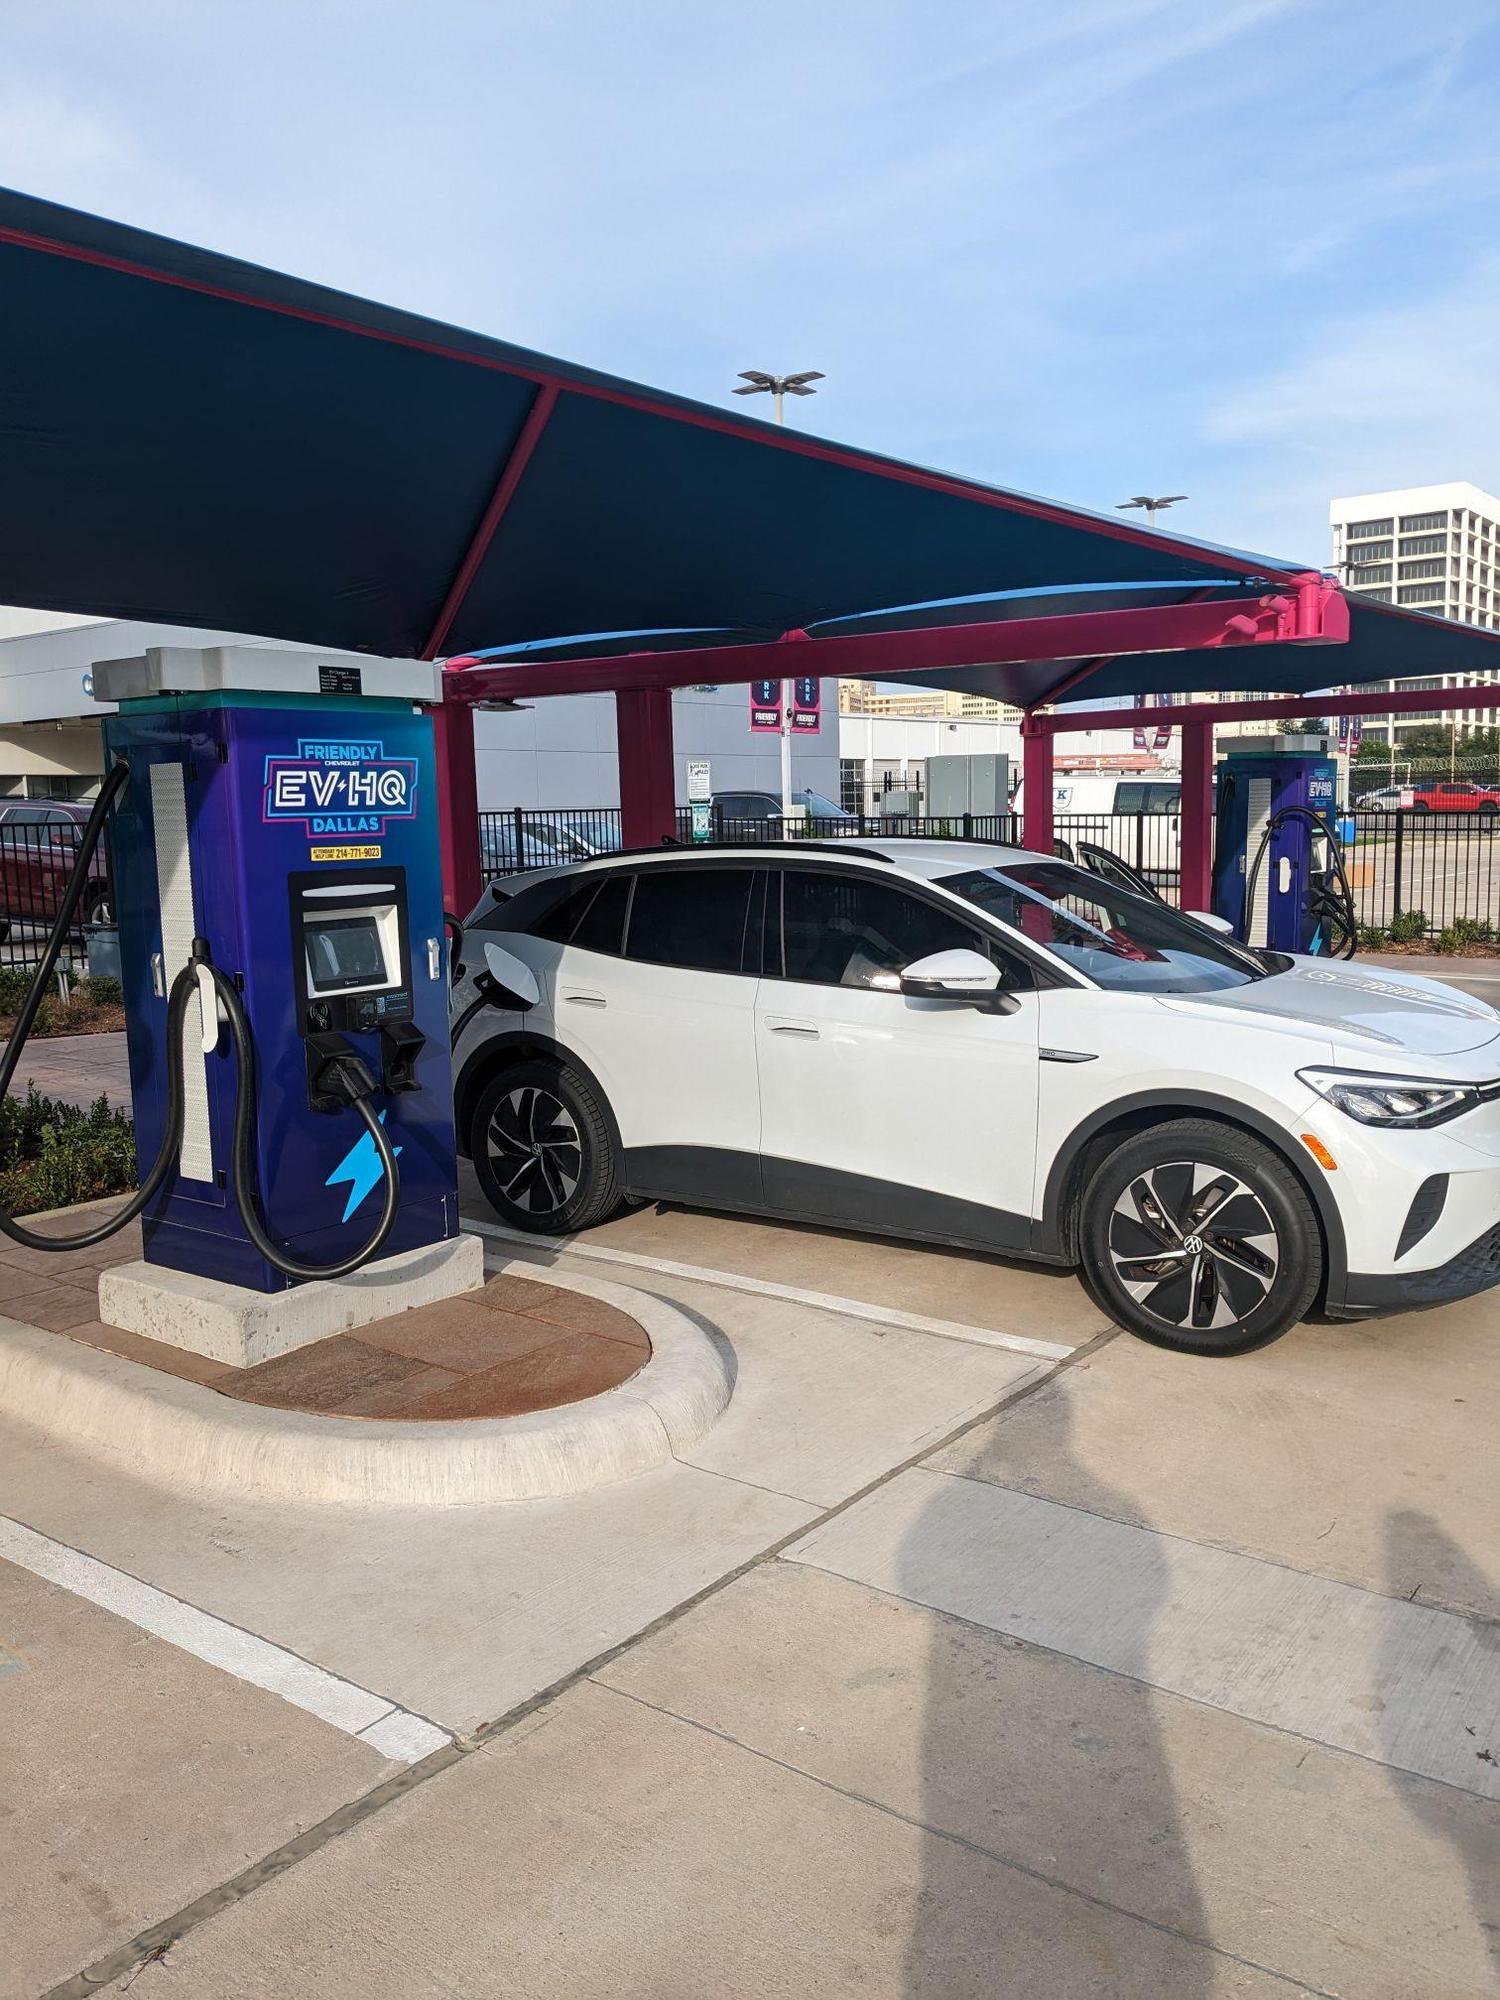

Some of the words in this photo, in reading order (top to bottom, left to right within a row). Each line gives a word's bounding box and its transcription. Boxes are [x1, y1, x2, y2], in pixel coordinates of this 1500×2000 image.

[755, 712, 777, 721] FRIENDLY
[304, 744, 377, 760] FRIENDLY
[1056, 789, 1068, 800] K
[312, 816, 379, 833] DALLAS
[335, 847, 380, 858] 214-771-9023
